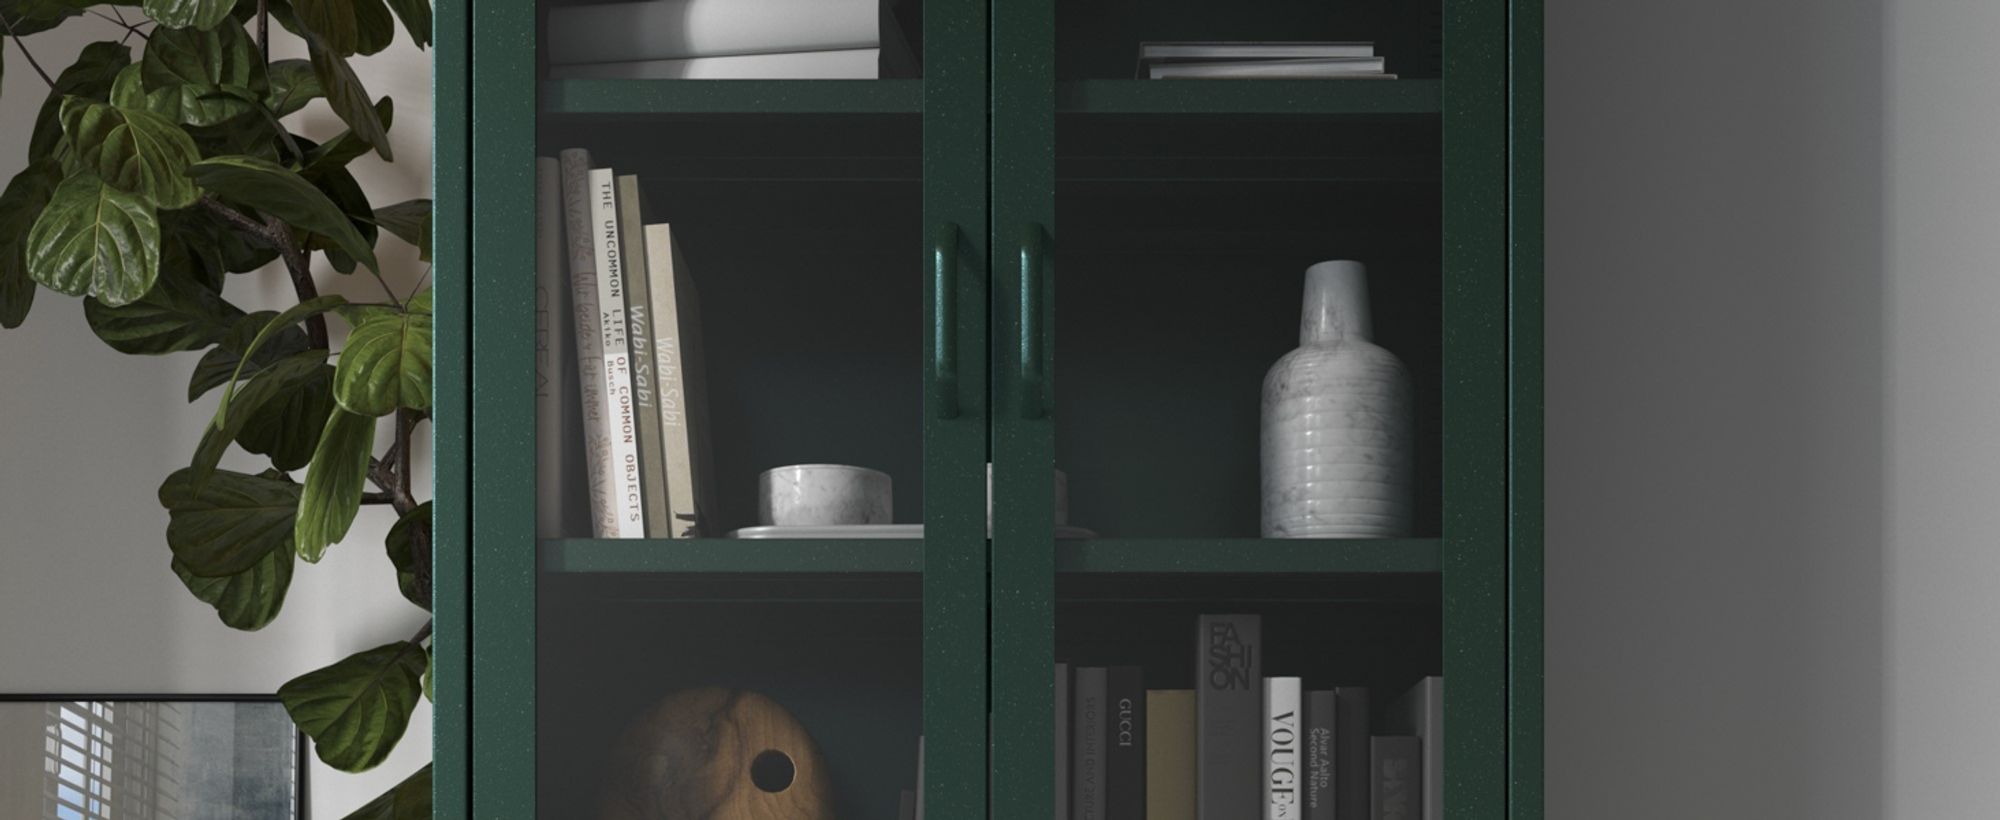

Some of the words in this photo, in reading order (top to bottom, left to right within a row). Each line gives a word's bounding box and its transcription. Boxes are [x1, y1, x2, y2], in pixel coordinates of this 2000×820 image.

[601, 181, 613, 209] THE
[604, 220, 620, 297] UNCOMMON
[603, 312, 612, 347] Akiko
[612, 308, 625, 346] LIFE
[616, 356, 627, 374] OF
[630, 305, 652, 408] Wabi-Sabi
[607, 360, 616, 395] Busch
[657, 337, 681, 427] Wabi-Sabi
[619, 386, 633, 442] COMMON
[625, 454, 640, 522] OBJECTS
[1119, 698, 1132, 746] GUCCI
[1271, 711, 1294, 803] VOUGE
[1308, 728, 1320, 767] Second
[1319, 728, 1330, 757] Alvar
[1308, 769, 1320, 809] Nature
[1319, 761, 1330, 787] Aalto
